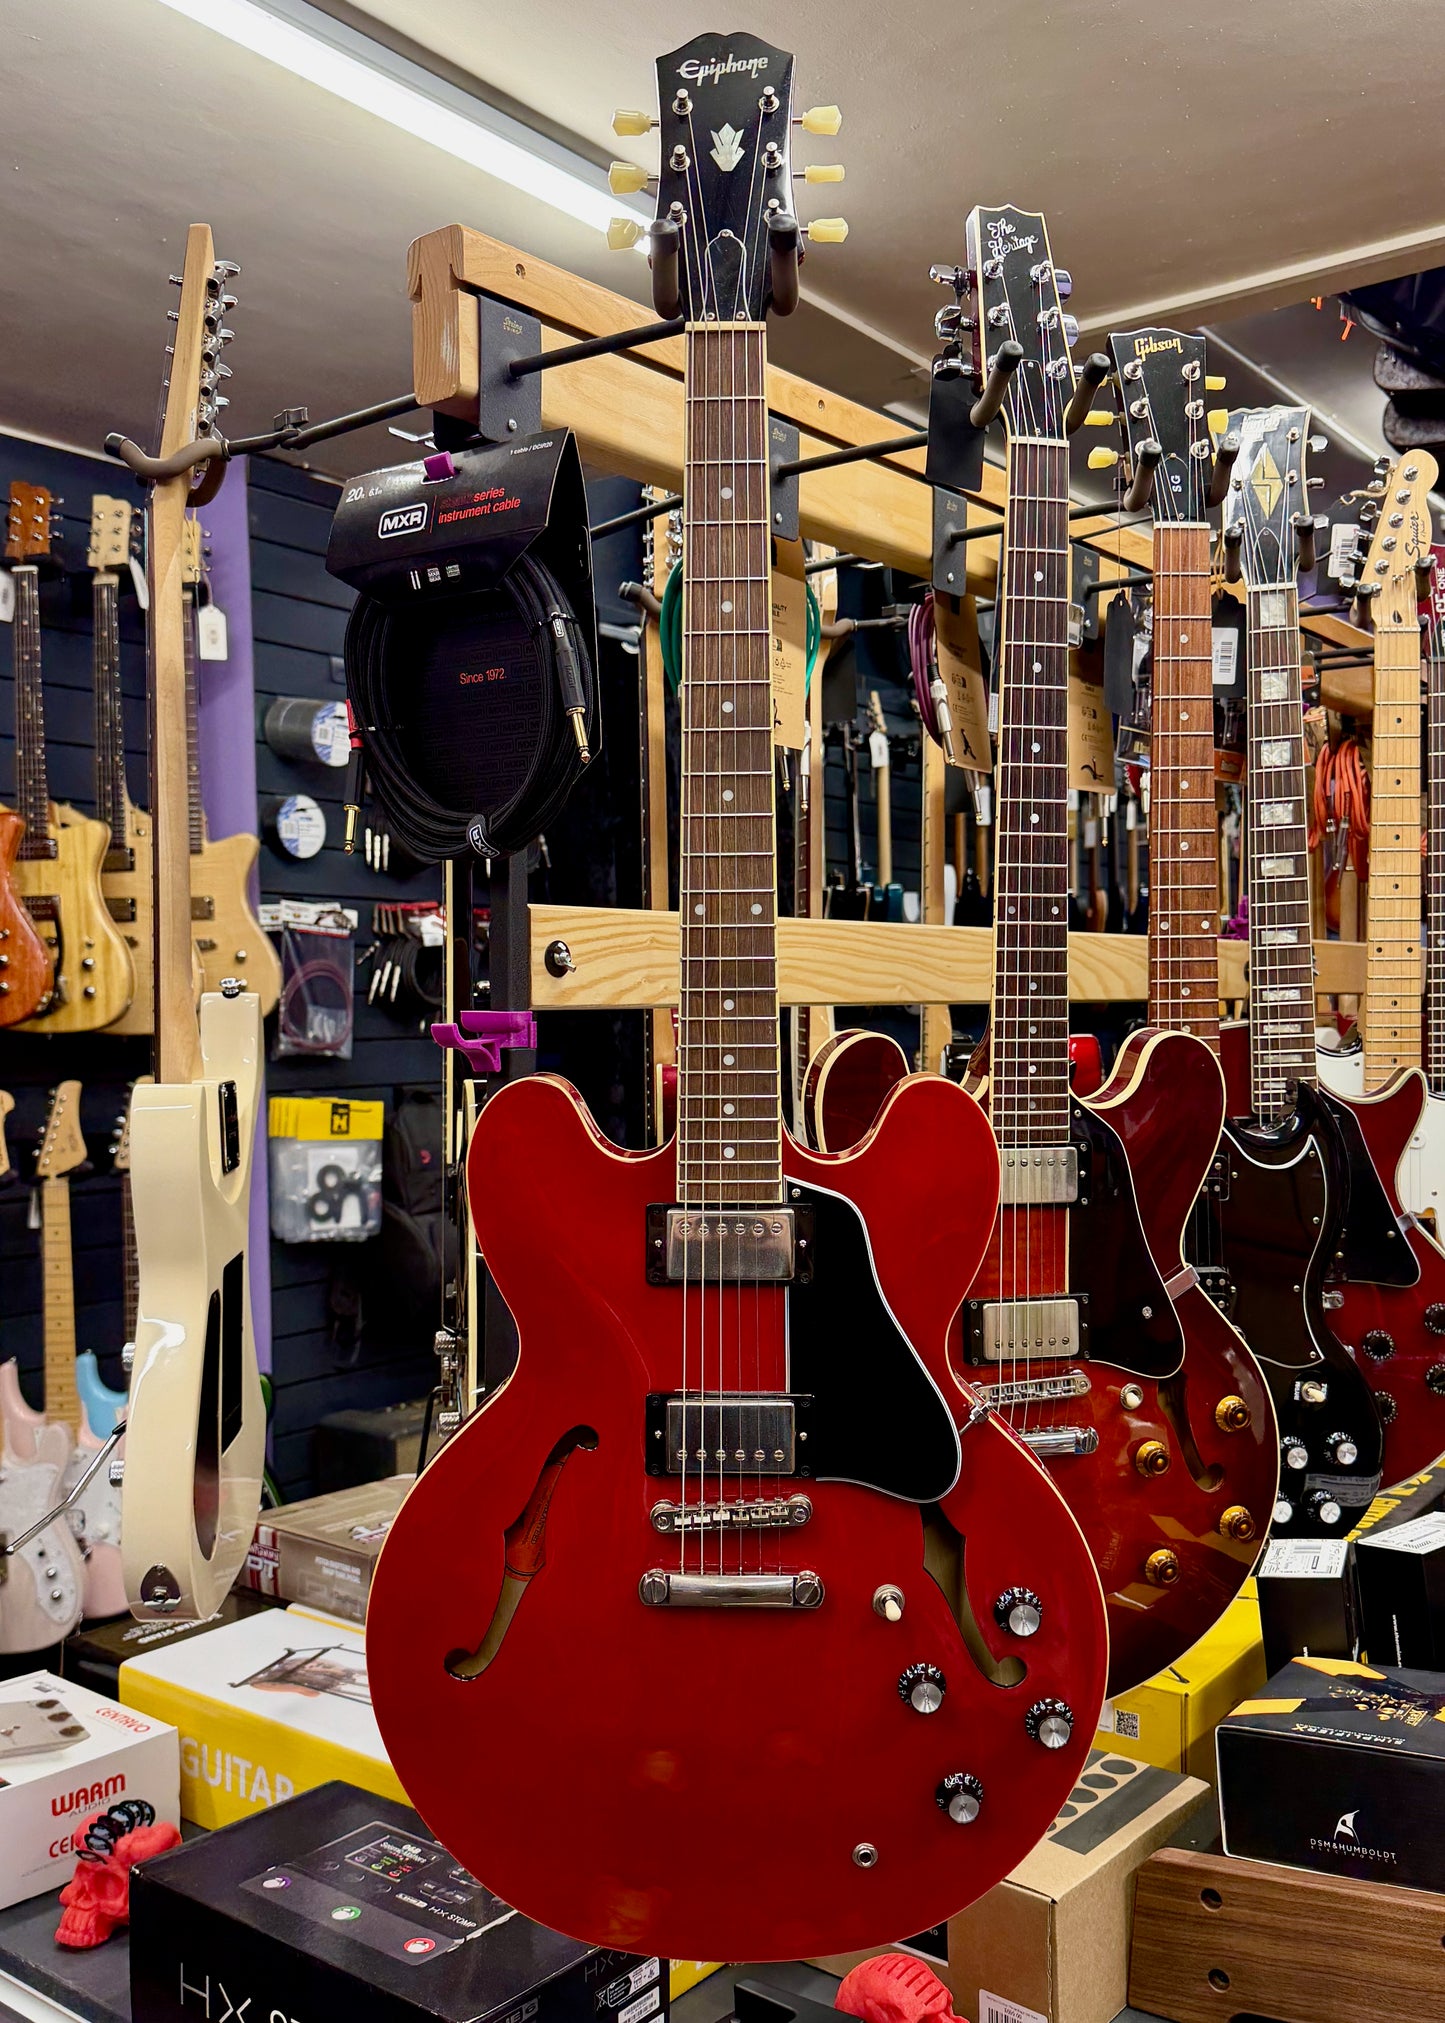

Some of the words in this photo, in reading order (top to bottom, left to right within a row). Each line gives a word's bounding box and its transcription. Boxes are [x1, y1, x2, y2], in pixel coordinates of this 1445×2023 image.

[676, 53, 768, 87] Epiphone
[987, 218, 1016, 239] The
[988, 235, 1039, 257] Heritage
[1134, 336, 1184, 362] Gibson
[1170, 475, 1182, 492] SG
[383, 511, 422, 532] MXR
[438, 503, 491, 524] instrument
[493, 496, 521, 513] cable
[1405, 511, 1427, 559] Squier
[460, 672, 484, 685] Since
[486, 667, 507, 681] 1972.
[472, 829, 496, 856] MXR
[51, 1773, 125, 1817] WARM
[69, 1798, 111, 1818] AUDIO
[1310, 1838, 1396, 1860] DSM&HUMBOLDT
[428, 1905, 449, 1918] HX
[447, 1913, 477, 1928] STOMP
[584, 1950, 614, 1984] HX
[180, 1962, 251, 2023] HX
